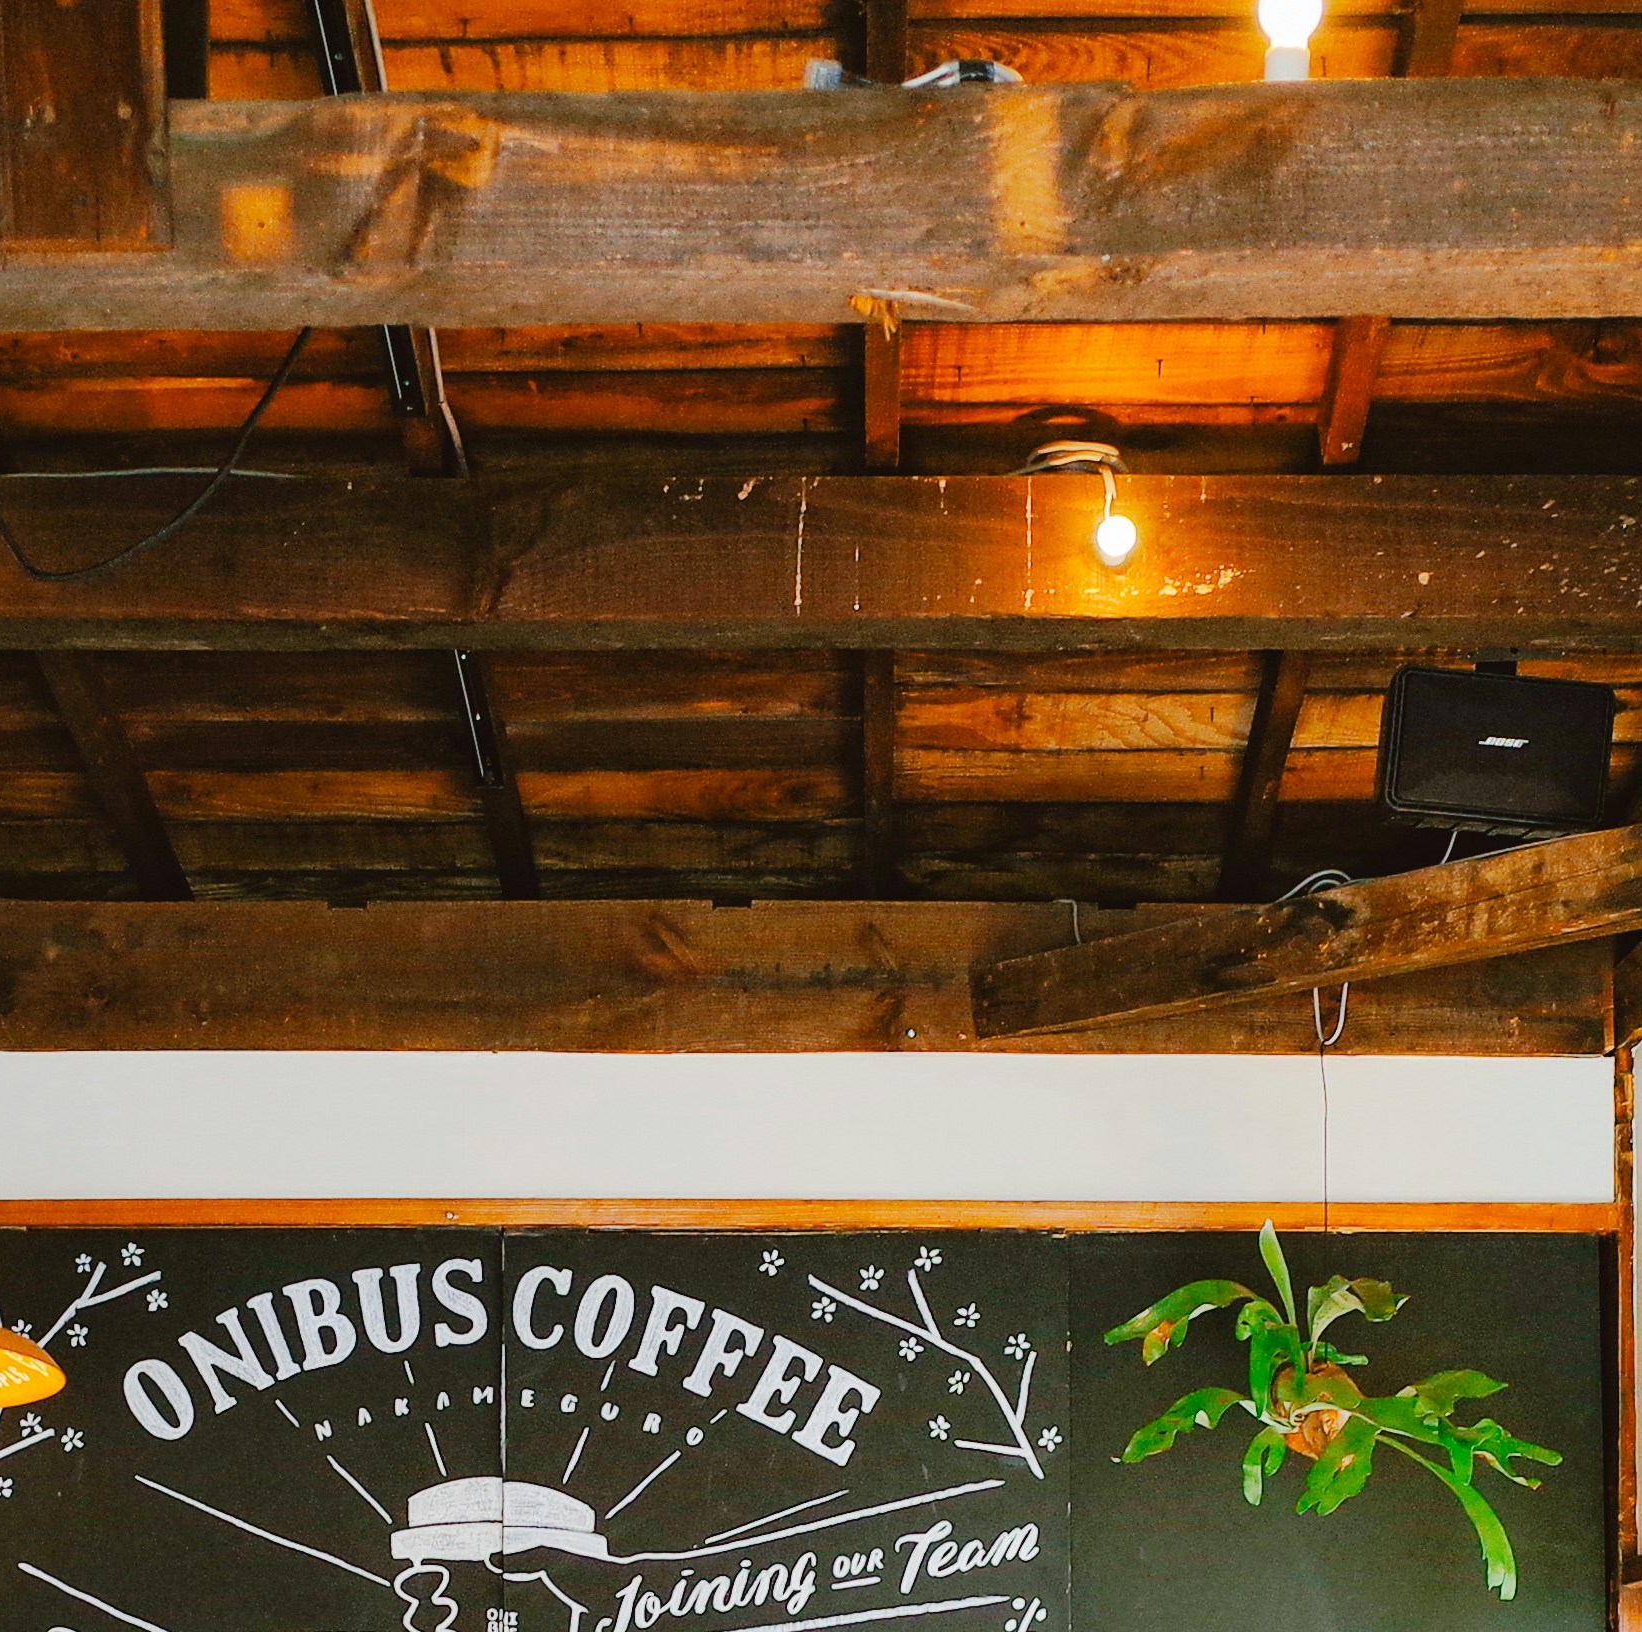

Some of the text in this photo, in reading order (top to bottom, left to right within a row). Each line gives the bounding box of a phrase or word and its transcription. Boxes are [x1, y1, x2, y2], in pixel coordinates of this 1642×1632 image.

[123, 1258, 881, 1467] ONIBUS COFFEE
[314, 1387, 704, 1445] NAKAMEGURO
[831, 1548, 884, 1580] OUR
[894, 1520, 1040, 1595] Team
